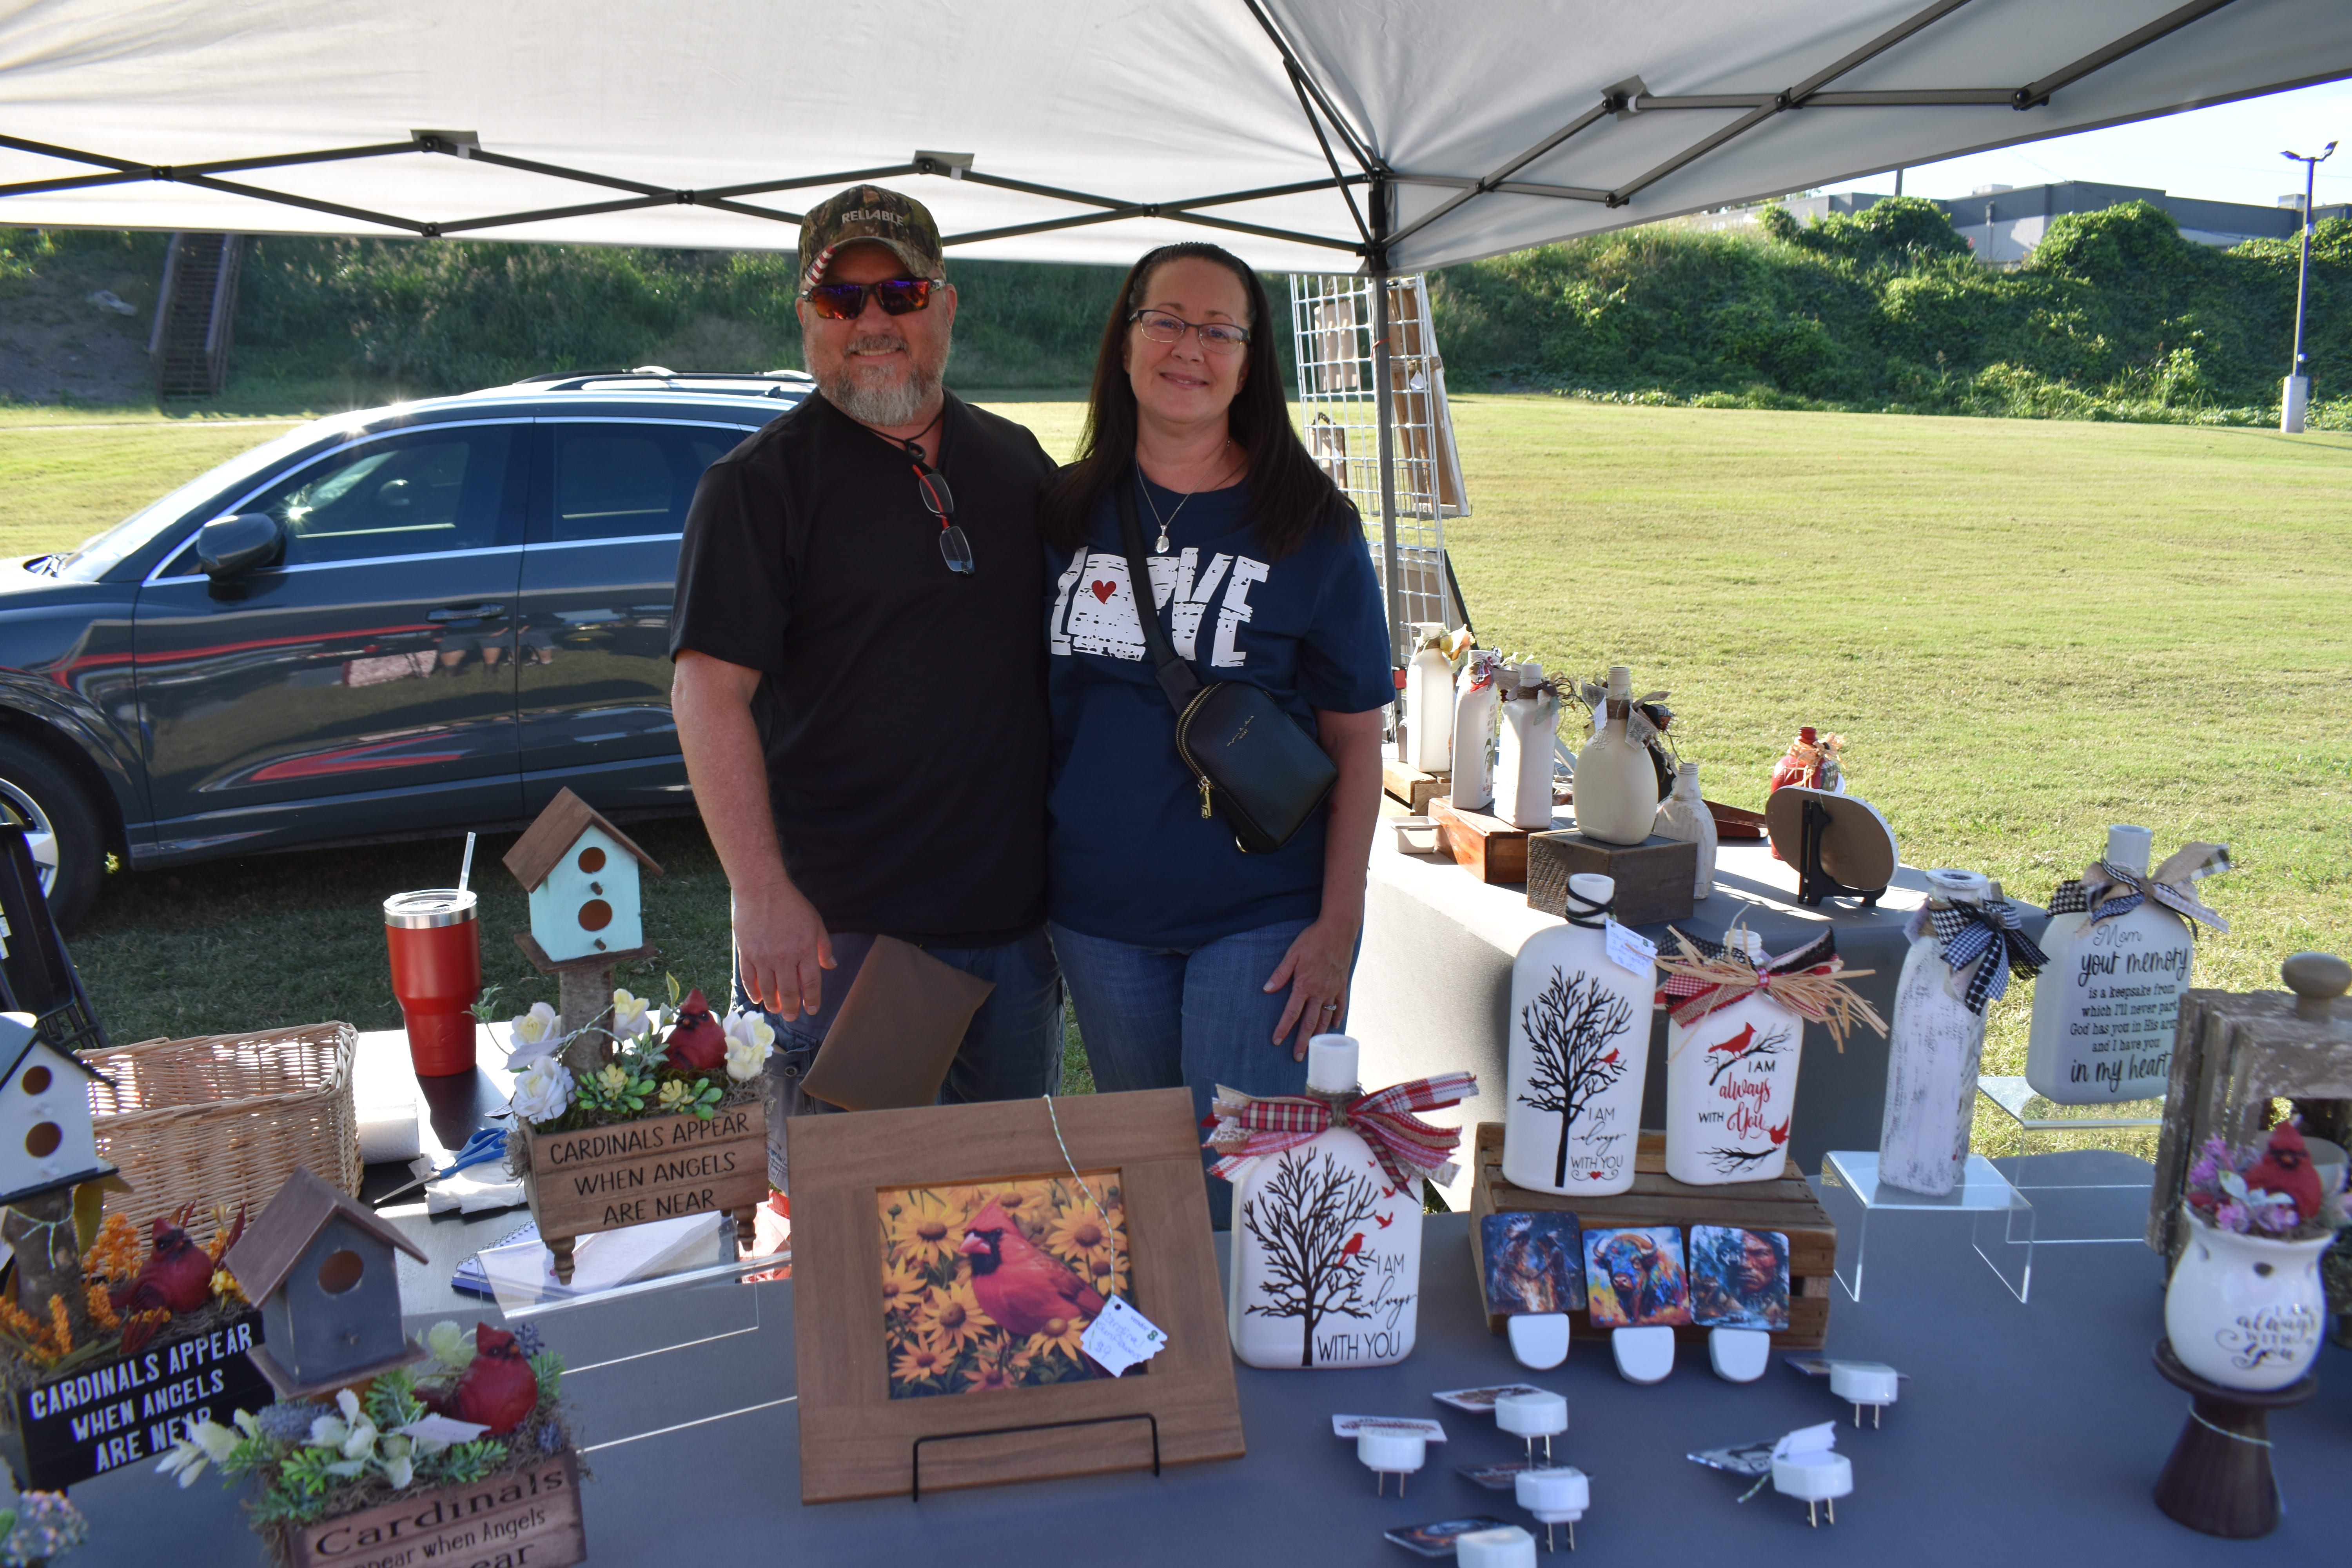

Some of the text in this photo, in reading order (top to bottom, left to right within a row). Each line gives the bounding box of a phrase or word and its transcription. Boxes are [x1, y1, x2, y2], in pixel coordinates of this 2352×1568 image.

[842, 209, 904, 227] RELIABLE
[2093, 924, 2142, 947] Mom
[2078, 947, 2188, 987] your memory
[2088, 983, 2175, 1000] is a keepsake from
[2082, 1004, 2112, 1017] which
[2114, 1003, 2128, 1015] I'll
[2130, 1004, 2158, 1014] never
[2070, 1023, 2090, 1036] God
[2092, 1022, 2110, 1035] has
[2110, 1024, 2130, 1037] you
[2131, 1020, 2142, 1033] in
[2143, 1019, 2159, 1031] His
[2091, 1038, 2161, 1053] and I have you
[1748, 1060, 1775, 1073] I AM
[2071, 1051, 2173, 1093] in my heart
[1719, 1071, 1771, 1114] always
[1589, 1107, 1615, 1121] I AM
[1699, 1111, 1724, 1123] WITH
[550, 1112, 750, 1165] CARDINALS APPEAR
[1572, 1120, 1627, 1157] always
[574, 1152, 735, 1196] WHEN ANGELS
[1571, 1155, 1623, 1169] WITH YOU
[603, 1189, 715, 1225] ARE NEAR
[1377, 1254, 1404, 1275] I AM
[1361, 1276, 1417, 1330] always
[1147, 1330, 1159, 1341] 8
[1317, 1331, 1400, 1361] WITH YOU
[30, 1323, 253, 1421] CARDINALS APPEAR
[71, 1368, 225, 1443] WHEN ANGELS
[96, 1430, 144, 1473] ARE
[315, 1470, 564, 1557] Cardinals
[423, 1532, 475, 1559] when
[483, 1507, 546, 1543] Angels
